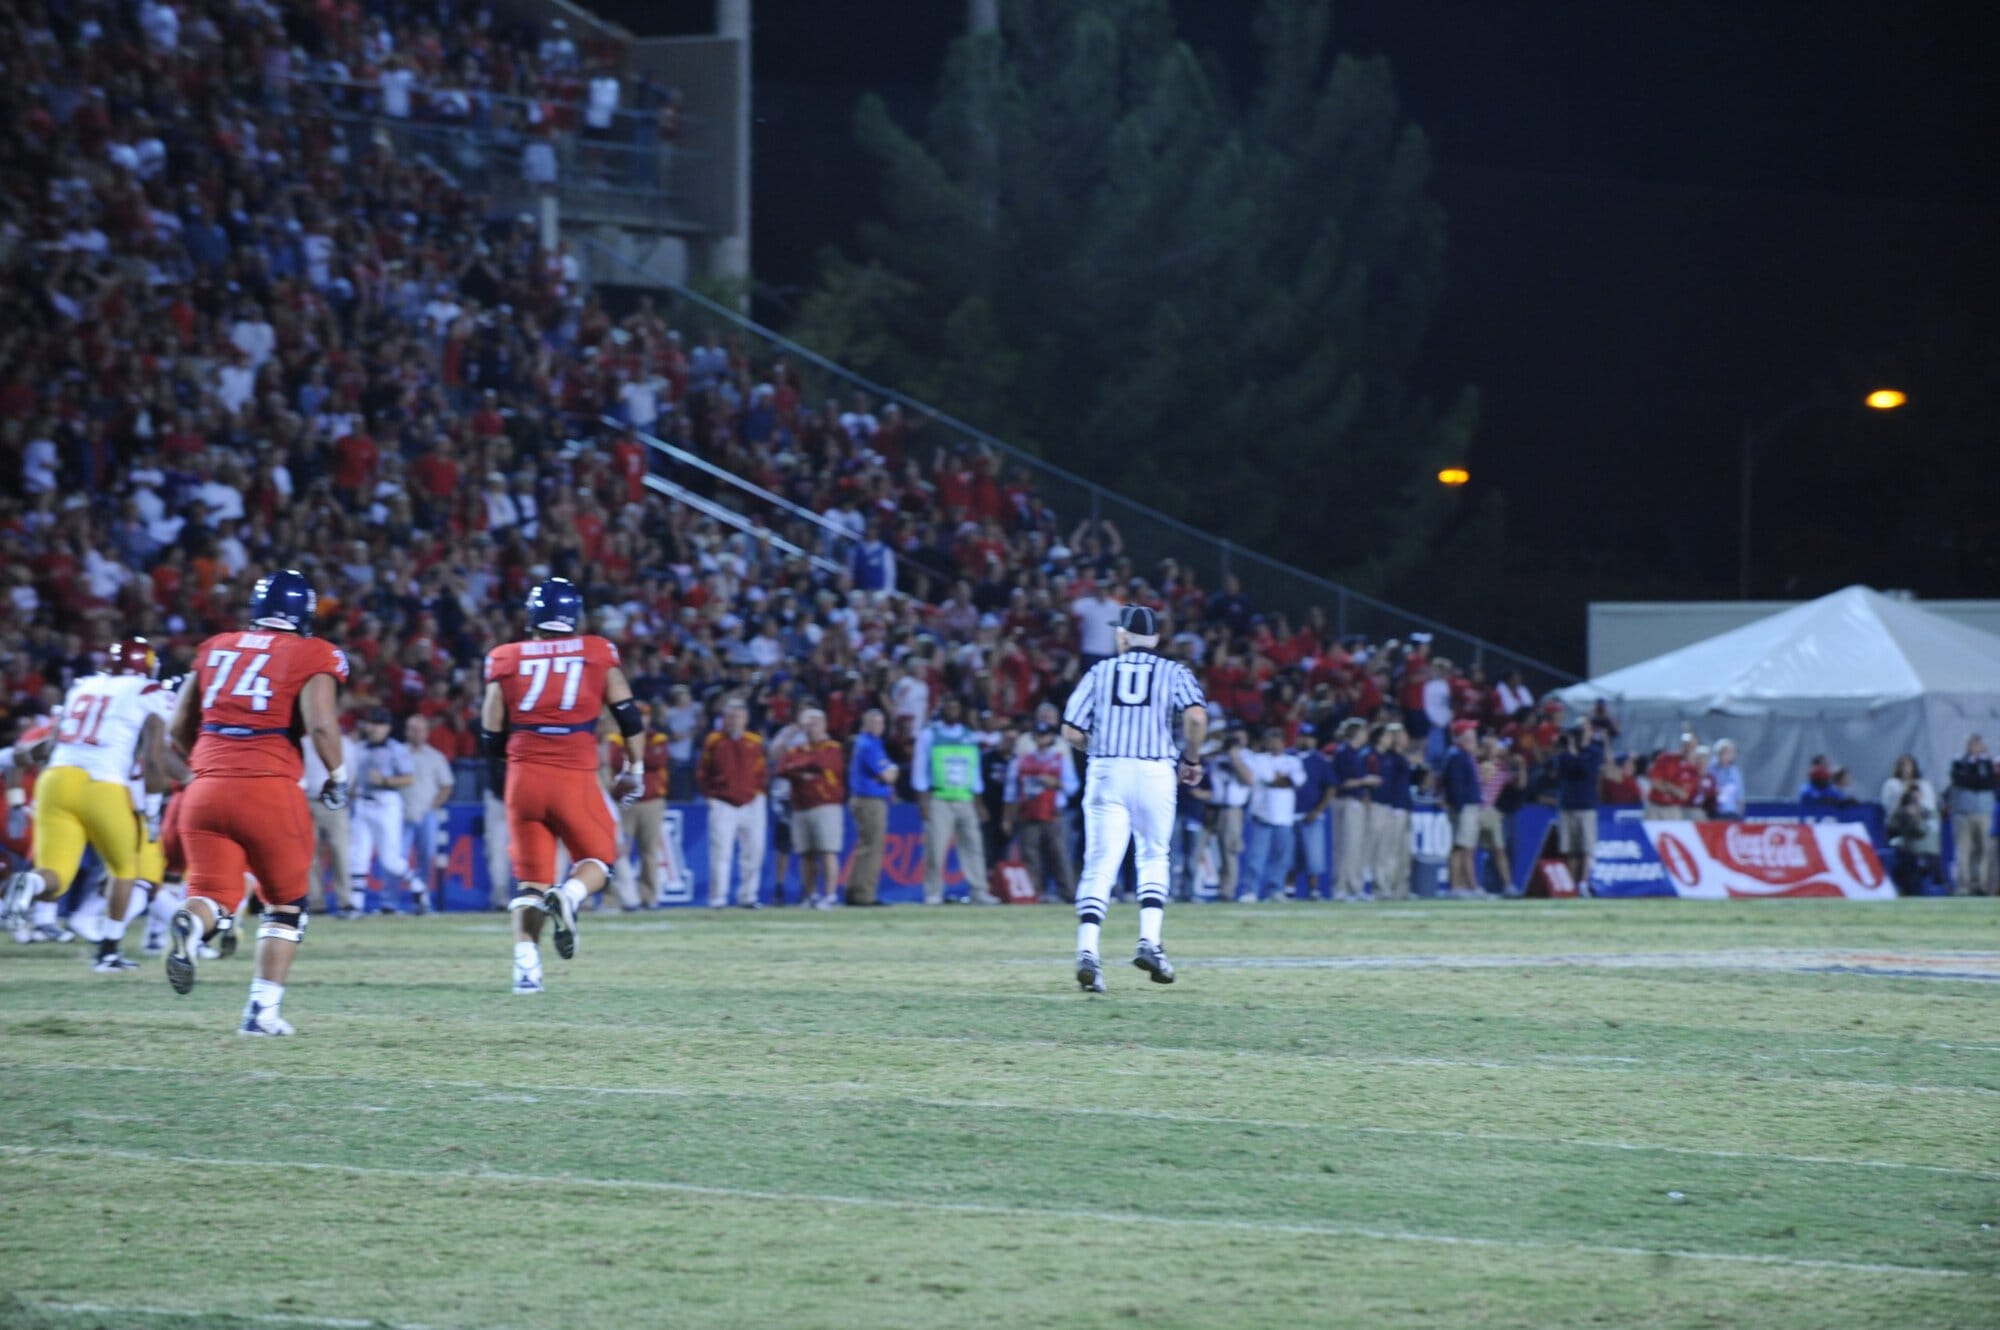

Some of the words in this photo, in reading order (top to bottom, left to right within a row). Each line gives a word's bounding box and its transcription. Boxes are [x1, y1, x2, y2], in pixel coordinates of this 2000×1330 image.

[202, 649, 273, 711] 74
[518, 656, 585, 712] 77
[1117, 663, 1153, 704] U
[58, 694, 112, 746] 91
